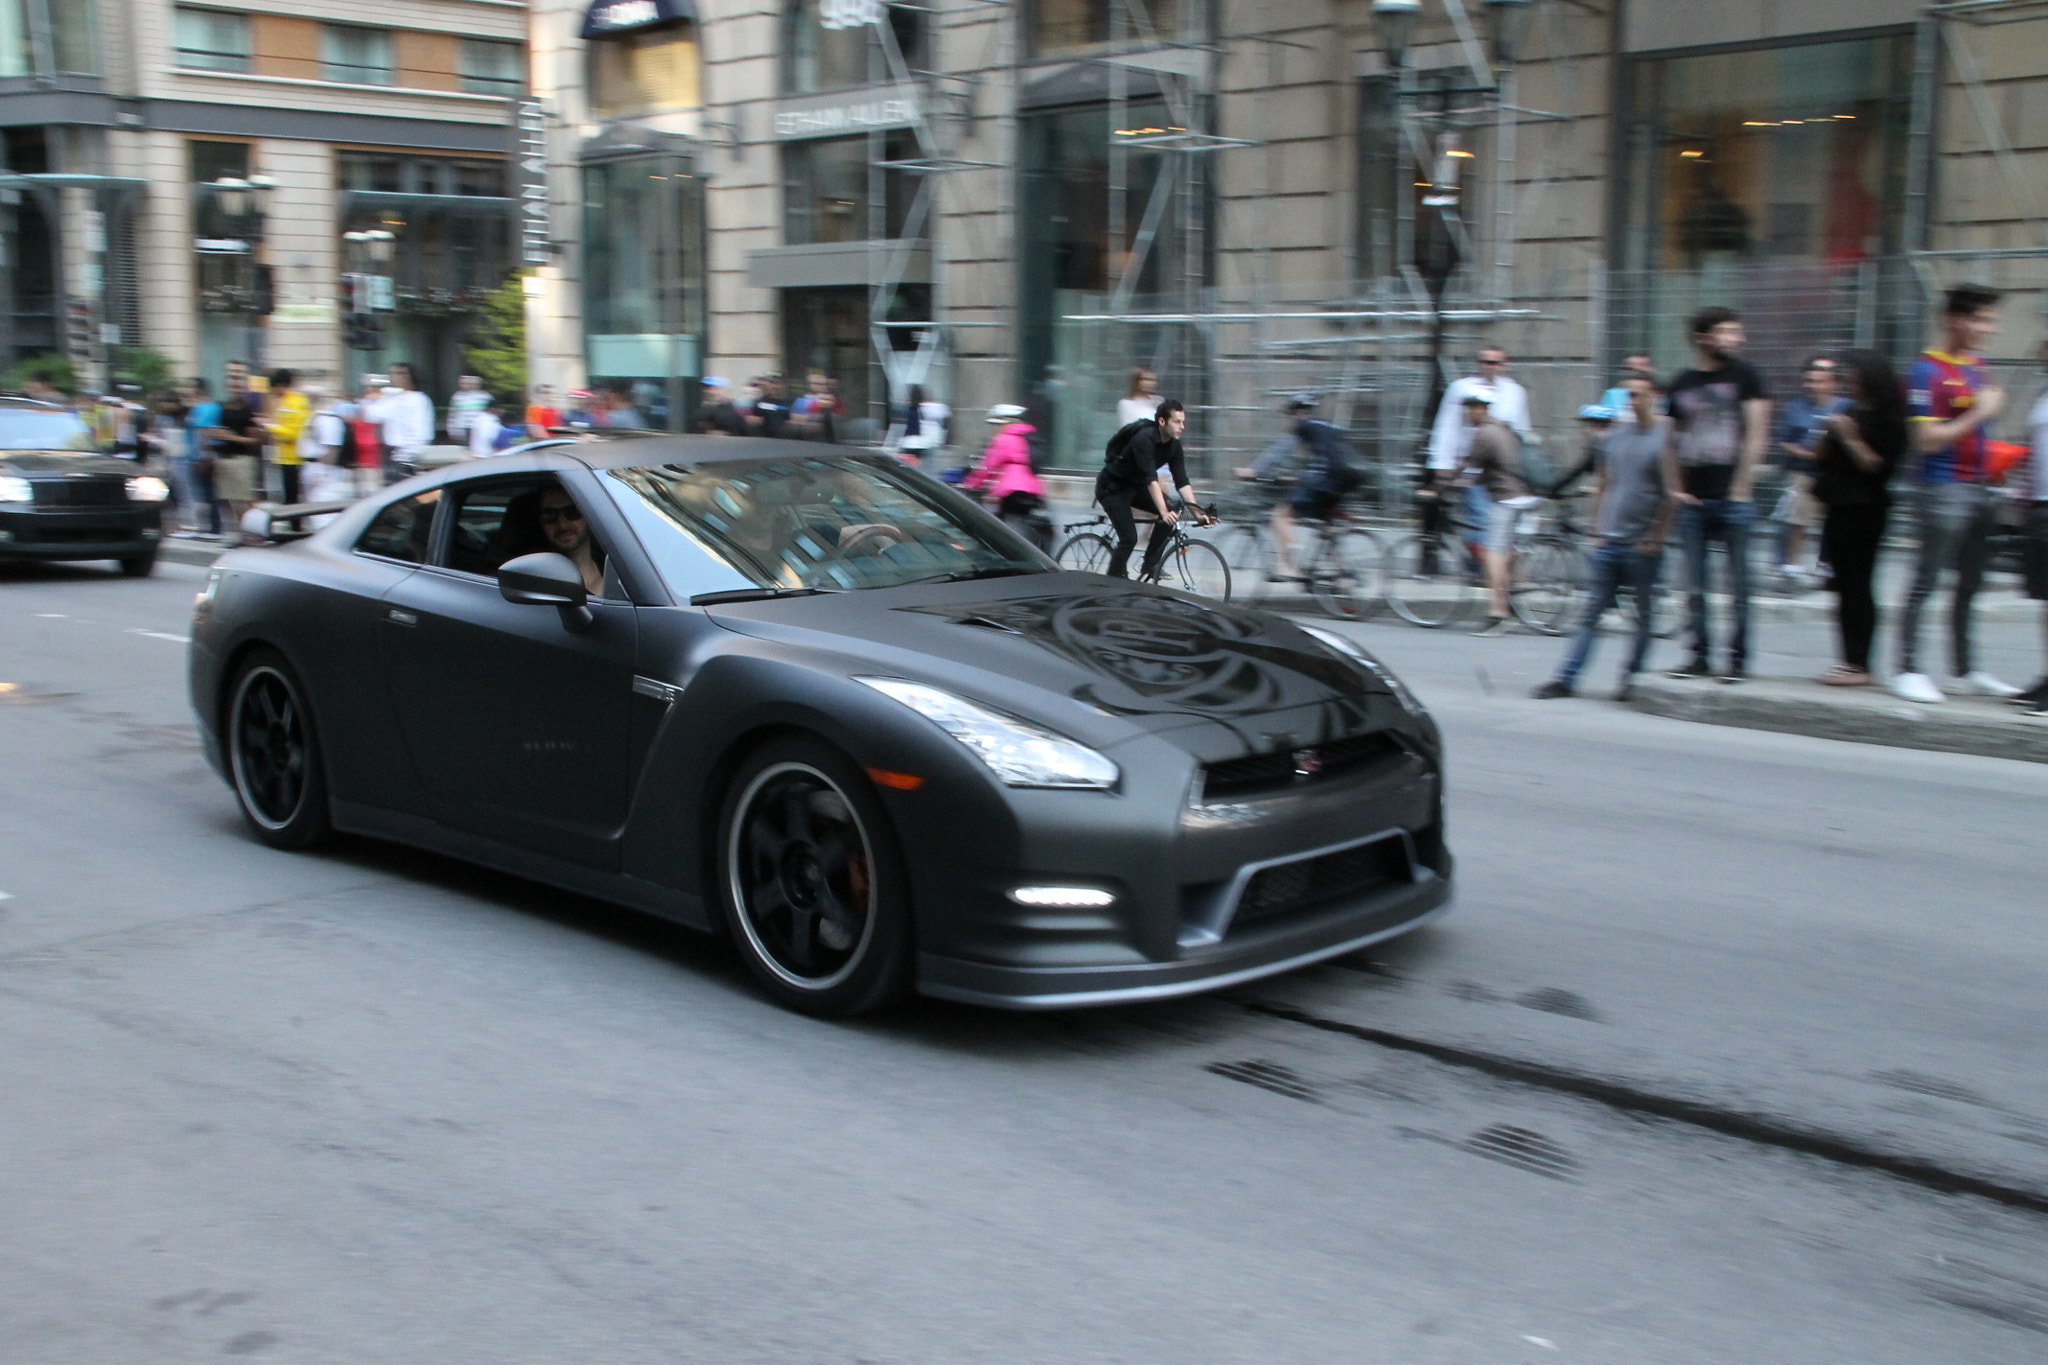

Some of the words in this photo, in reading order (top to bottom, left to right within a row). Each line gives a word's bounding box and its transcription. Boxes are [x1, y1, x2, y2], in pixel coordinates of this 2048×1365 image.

[517, 101, 549, 175] ALLEN
[775, 107, 850, 135] ETHAN
[520, 183, 551, 263] ETHAN
